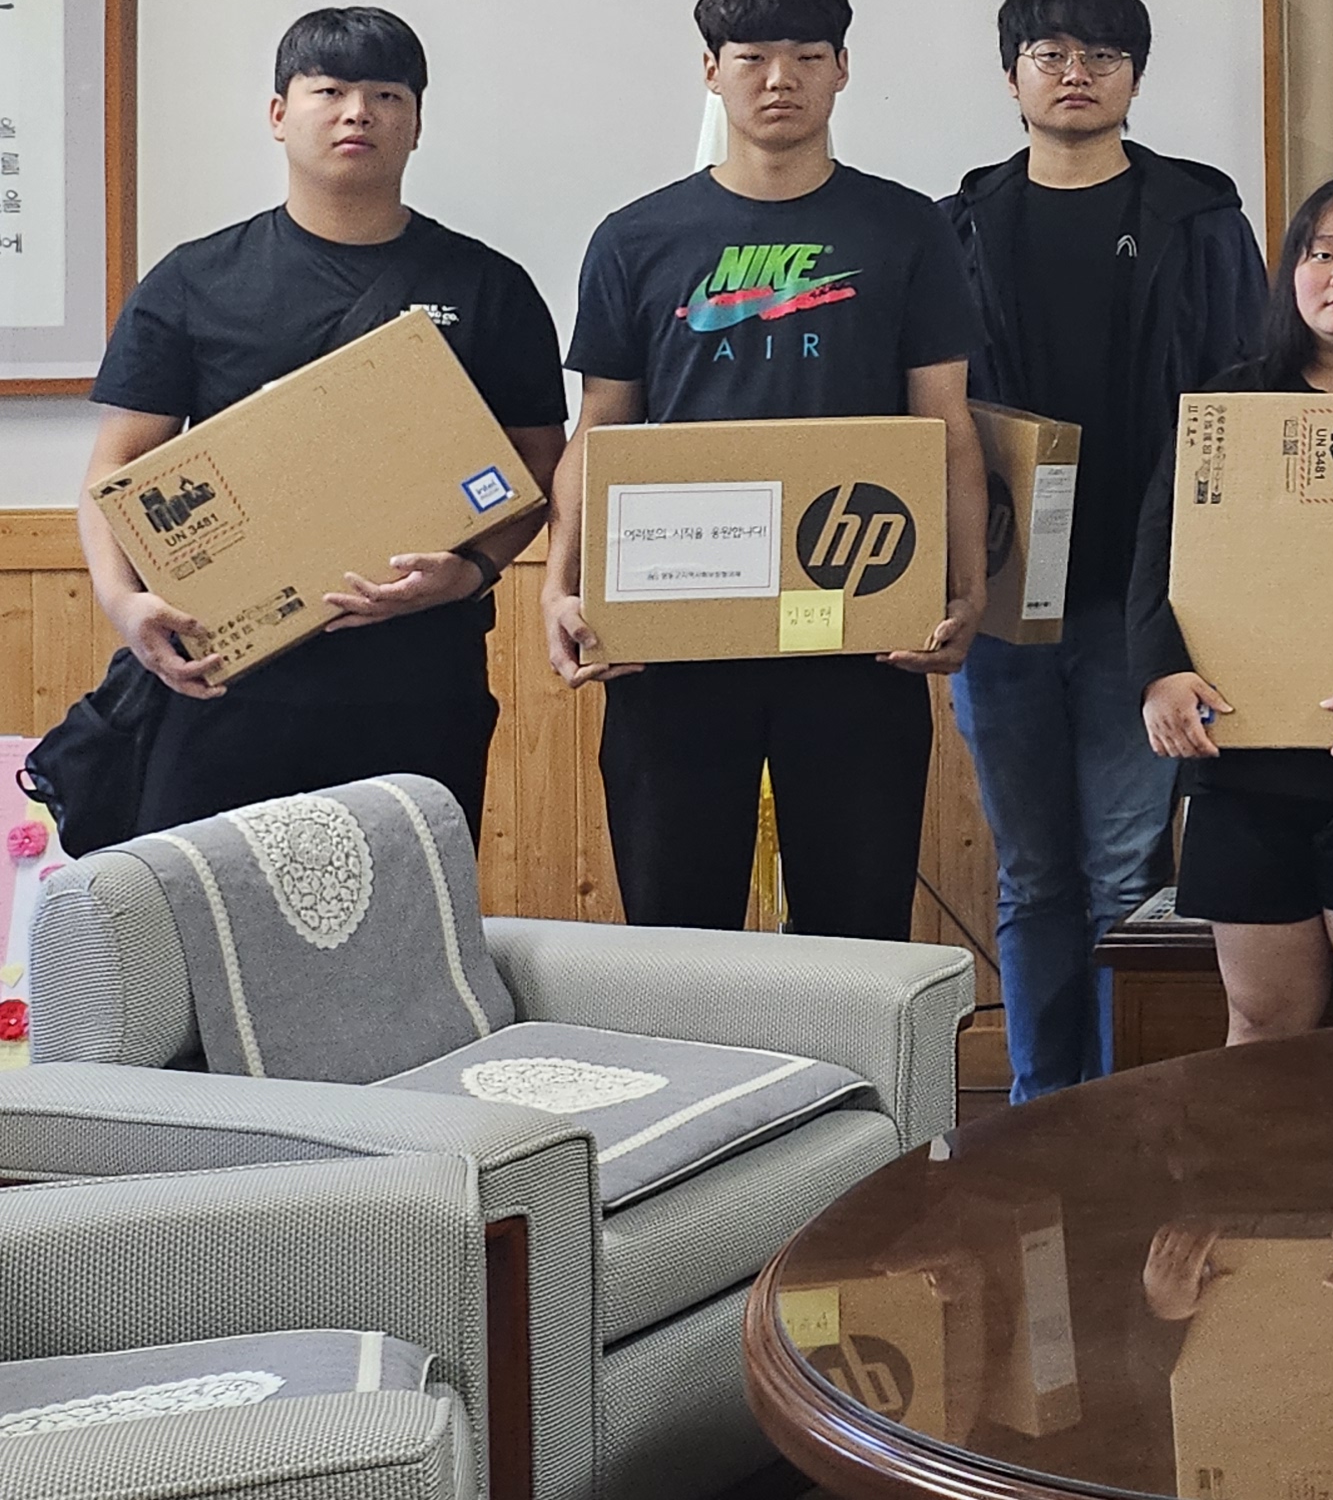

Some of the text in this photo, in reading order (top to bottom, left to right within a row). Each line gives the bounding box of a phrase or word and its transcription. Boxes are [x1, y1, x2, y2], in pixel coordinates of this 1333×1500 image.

[709, 244, 824, 292] NIKE
[713, 333, 820, 362] AIR
[1314, 428, 1328, 481] UN 3481
[164, 513, 220, 548] UN 3481
[808, 483, 907, 599] hp
